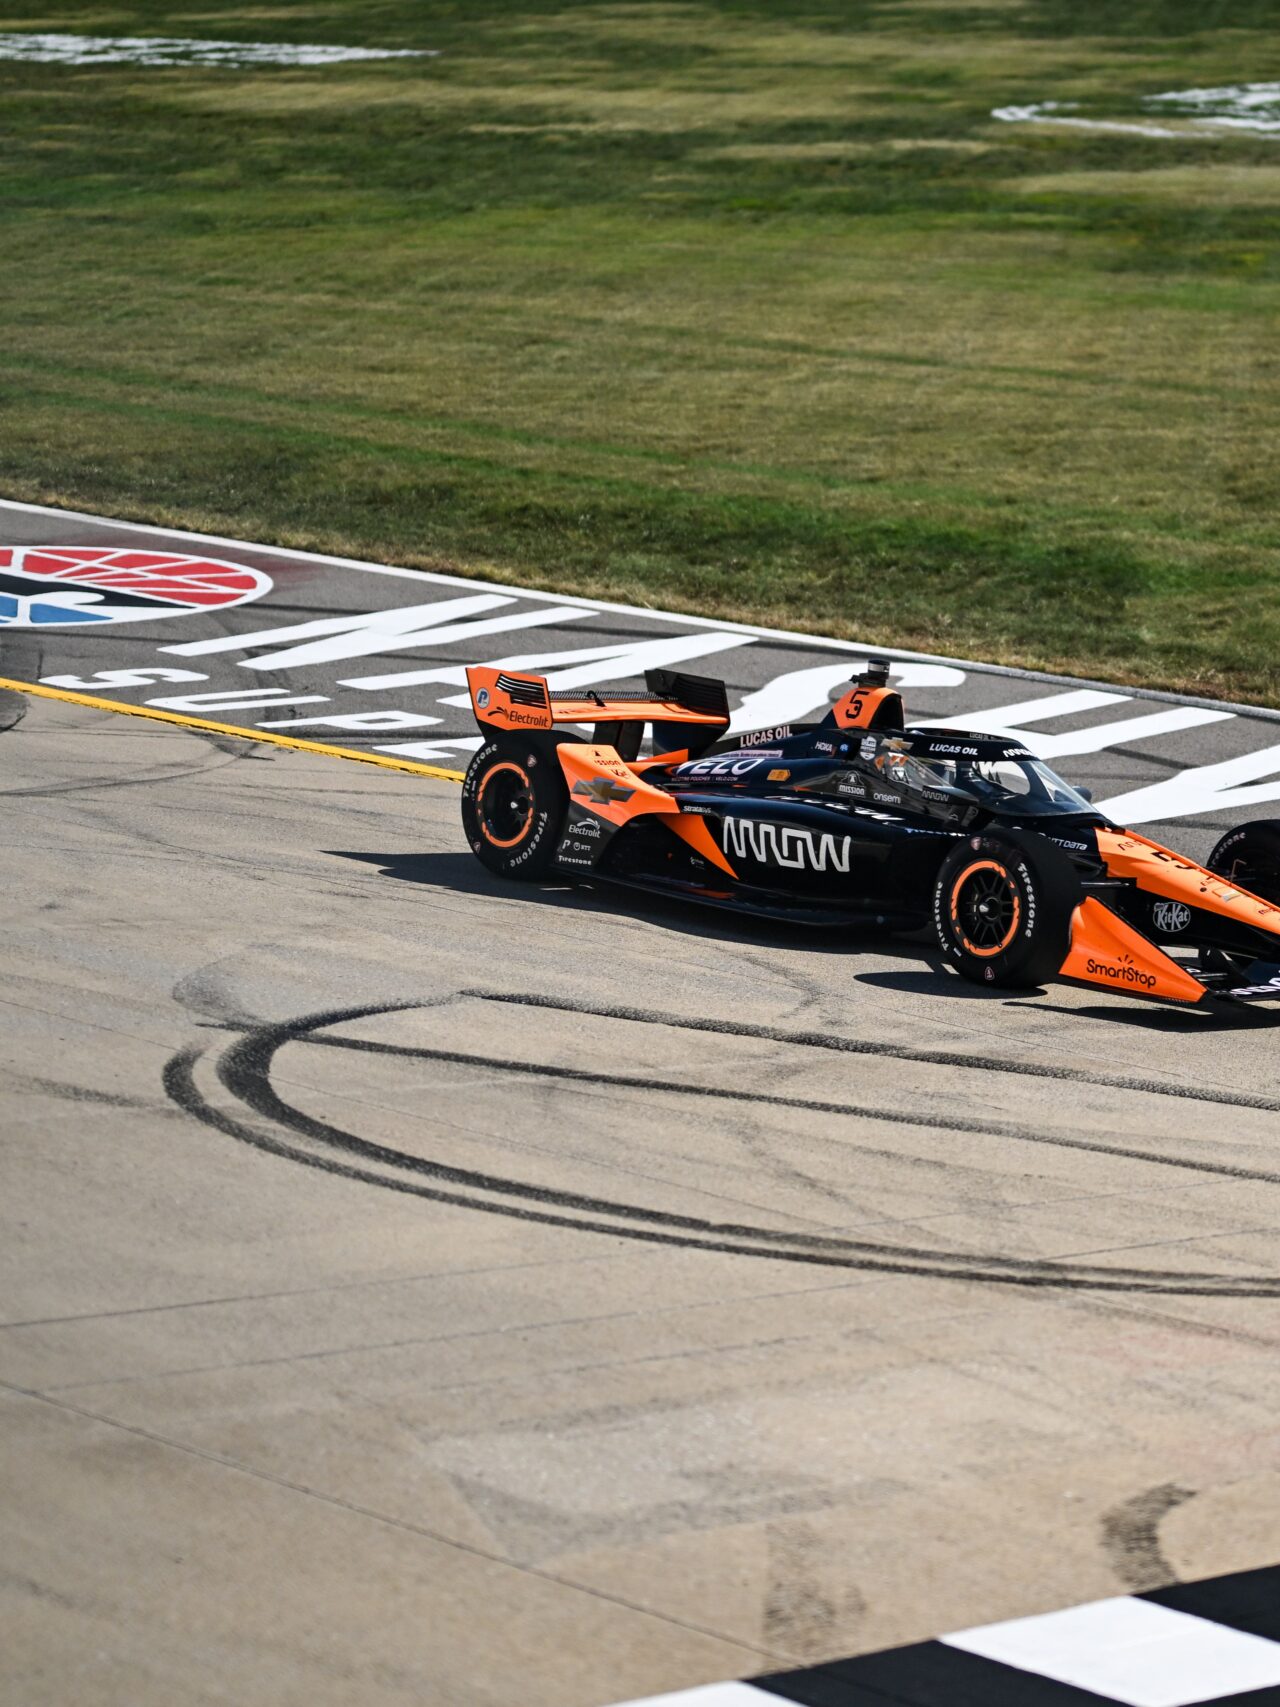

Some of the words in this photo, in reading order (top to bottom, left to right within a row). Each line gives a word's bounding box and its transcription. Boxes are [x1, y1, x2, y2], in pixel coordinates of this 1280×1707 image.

[845, 690, 870, 719] 5
[509, 710, 549, 728] Electrolit
[740, 729, 773, 748] LUCAS
[775, 725, 793, 739] OIL
[929, 743, 961, 754] LUCAS
[961, 746, 979, 756] OIL
[568, 824, 601, 838] Electrolit
[723, 815, 851, 872] ARROW
[558, 855, 592, 865] Firestone
[1017, 862, 1037, 938] Firestone
[1157, 903, 1189, 931] KitKat
[1086, 959, 1157, 988] SmartStop
